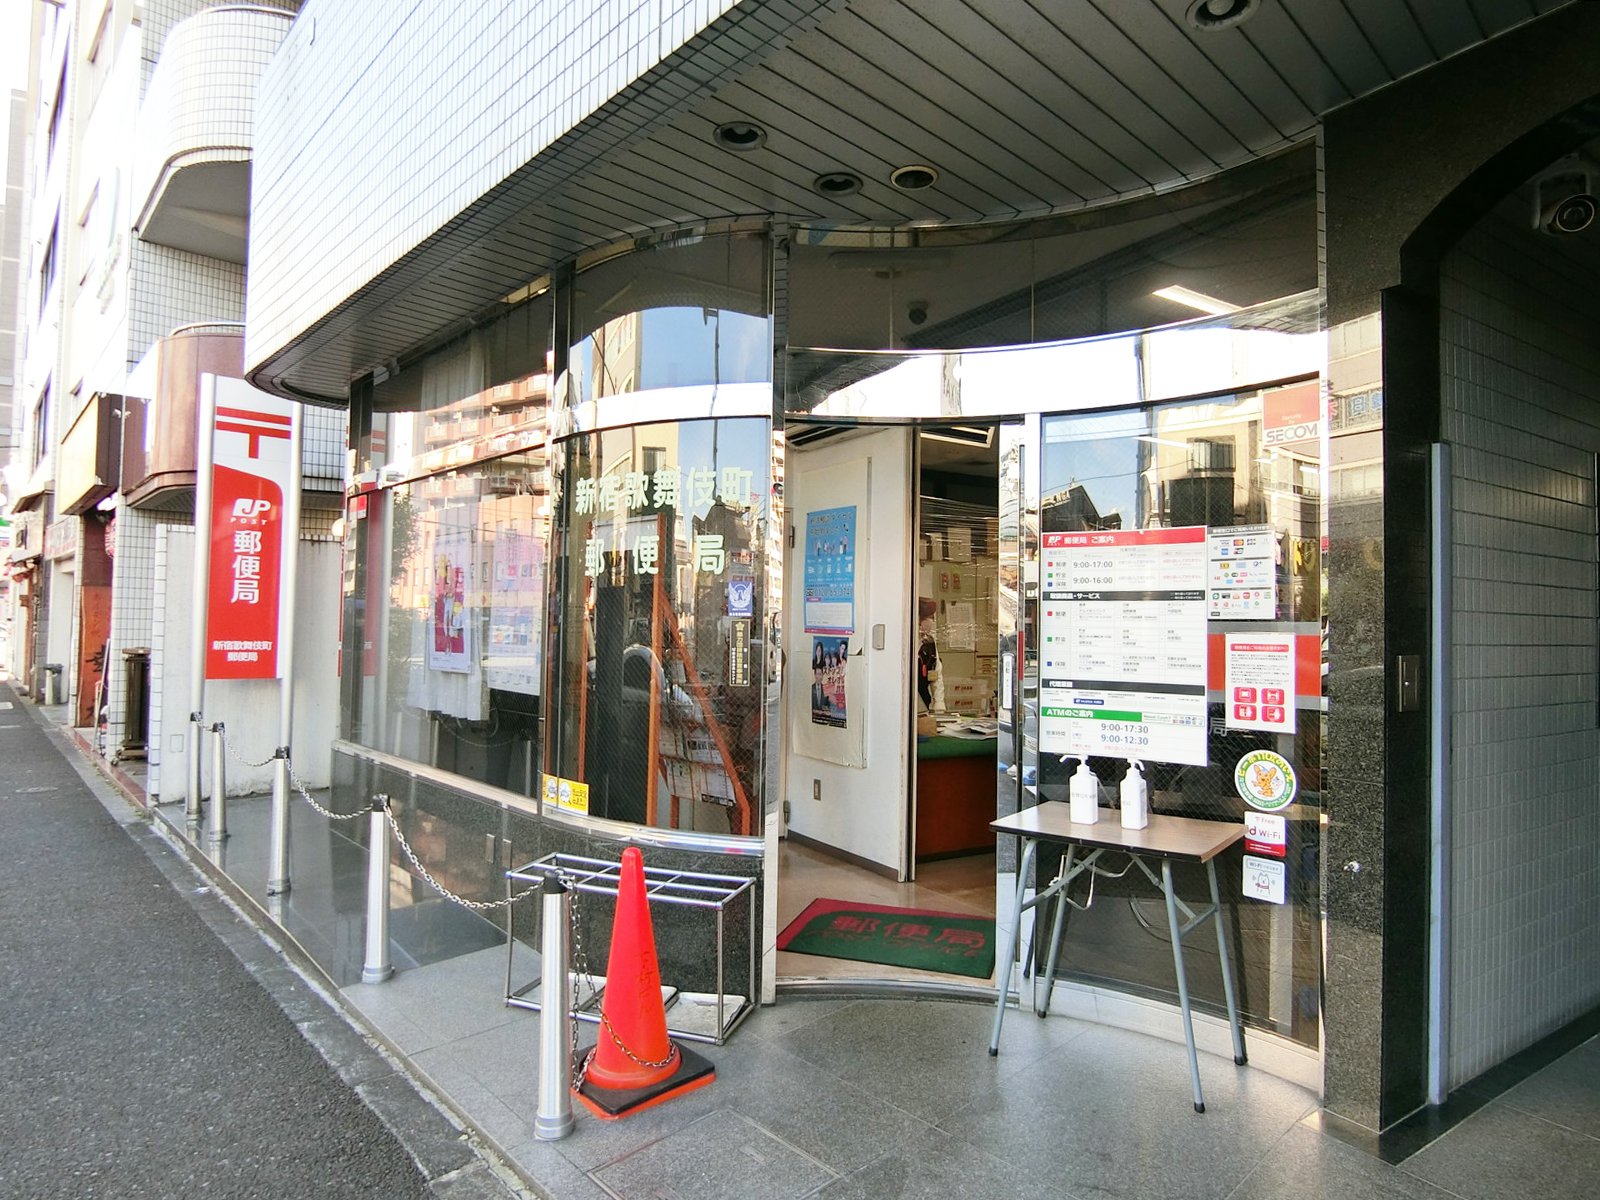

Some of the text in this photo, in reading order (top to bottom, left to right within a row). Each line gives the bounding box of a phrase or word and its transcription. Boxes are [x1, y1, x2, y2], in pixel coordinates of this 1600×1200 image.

[1266, 422, 1319, 444] SECOM
[575, 465, 754, 516] 新宿歌舞伎町
[230, 517, 268, 525] POST
[1064, 535, 1114, 545] 郵便局 ご案内
[230, 529, 262, 604] 郵便局
[1073, 560, 1113, 569] 9:00-17:00
[1073, 577, 1113, 585] 9:00-16:00
[212, 641, 273, 651] 新宿歌舞伎町
[227, 652, 259, 662] 郵便局
[1046, 707, 1094, 718] ATMのご案内
[1101, 722, 1149, 734] 9:00-17:30
[1101, 734, 1149, 745] 9:00-12:30
[1261, 816, 1276, 826] Free
[1259, 829, 1281, 840] Wi-Fi
[830, 915, 986, 948] 郵便局
